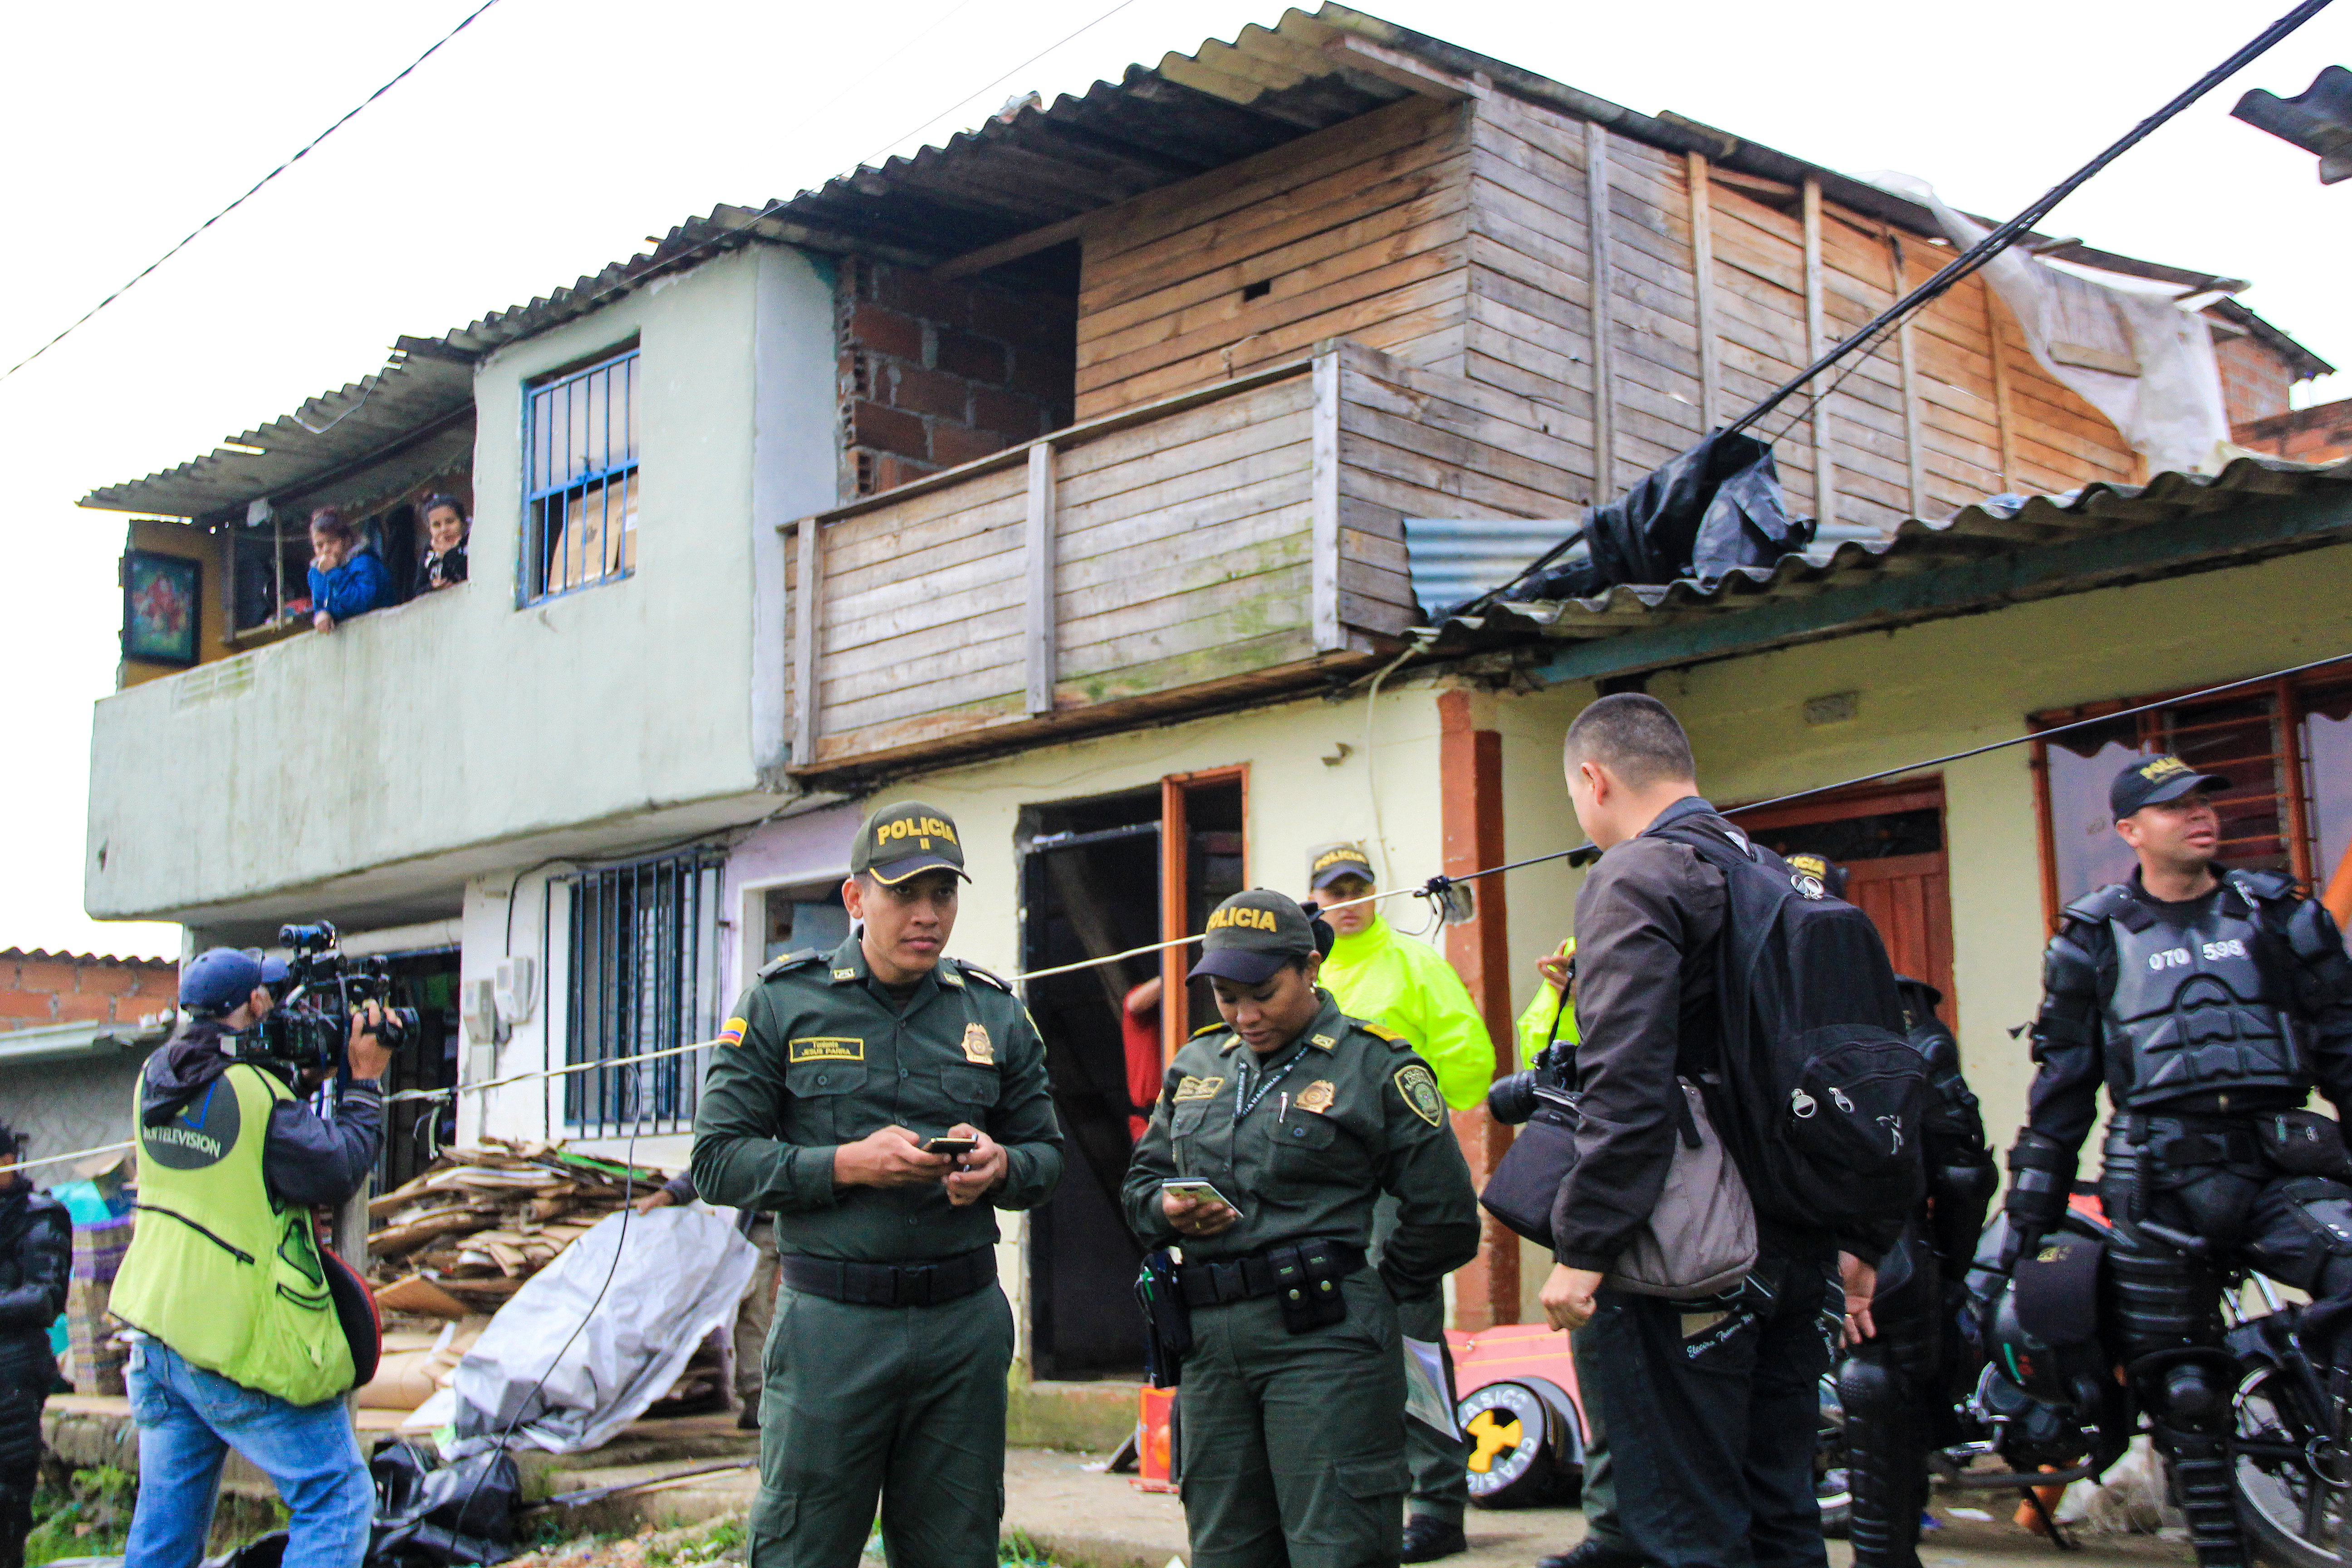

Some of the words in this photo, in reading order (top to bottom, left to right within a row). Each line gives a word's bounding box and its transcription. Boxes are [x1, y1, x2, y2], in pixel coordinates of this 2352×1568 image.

[877, 817, 957, 846] POLICIA
[2148, 947, 2190, 971] 070
[2202, 939, 2246, 961] 598
[159, 1126, 221, 1158] TELEVISION
